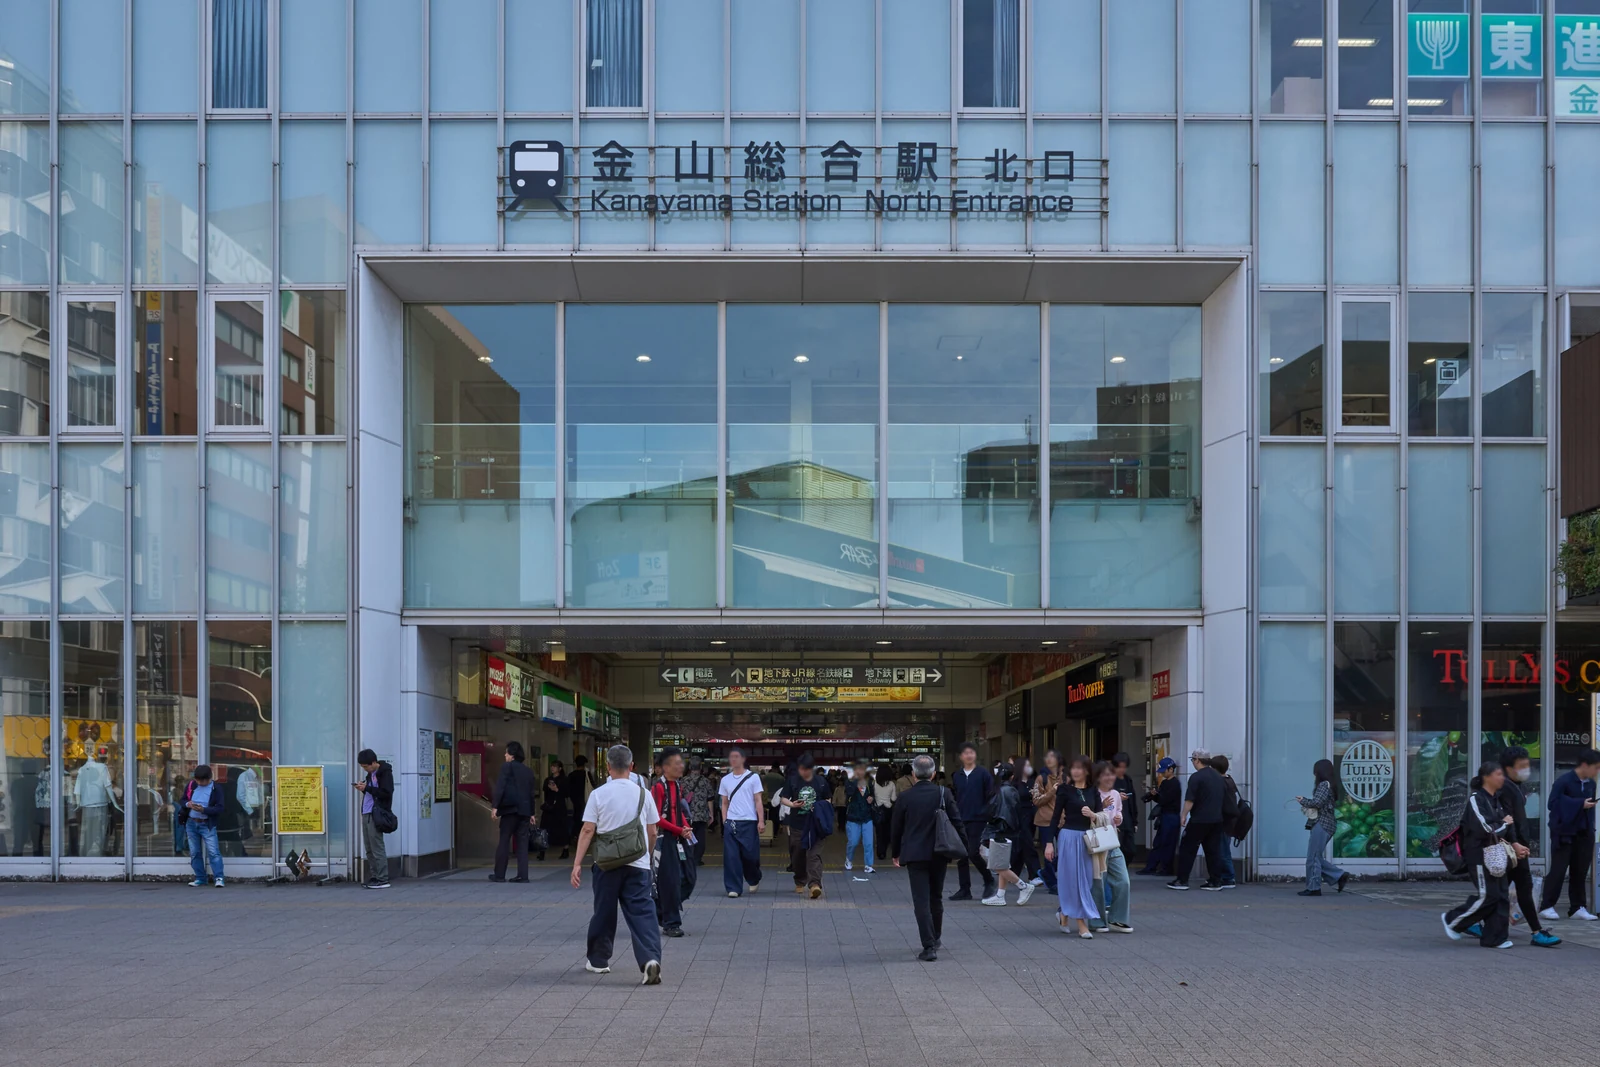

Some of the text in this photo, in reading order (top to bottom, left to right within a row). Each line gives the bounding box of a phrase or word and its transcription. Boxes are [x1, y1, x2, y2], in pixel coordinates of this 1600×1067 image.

[1489, 21, 1600, 71] 東進
[592, 140, 1075, 183] 金山総合駅 北口
[591, 189, 1074, 214] Kanayama Station North Entrance
[695, 668, 713, 678] 電話
[764, 668, 790, 678] 地下鉄
[791, 668, 815, 678] JR線
[816, 668, 843, 678] 名鉄線
[865, 668, 891, 678] 地下鉄
[1085, 681, 1105, 699] COFFEE
